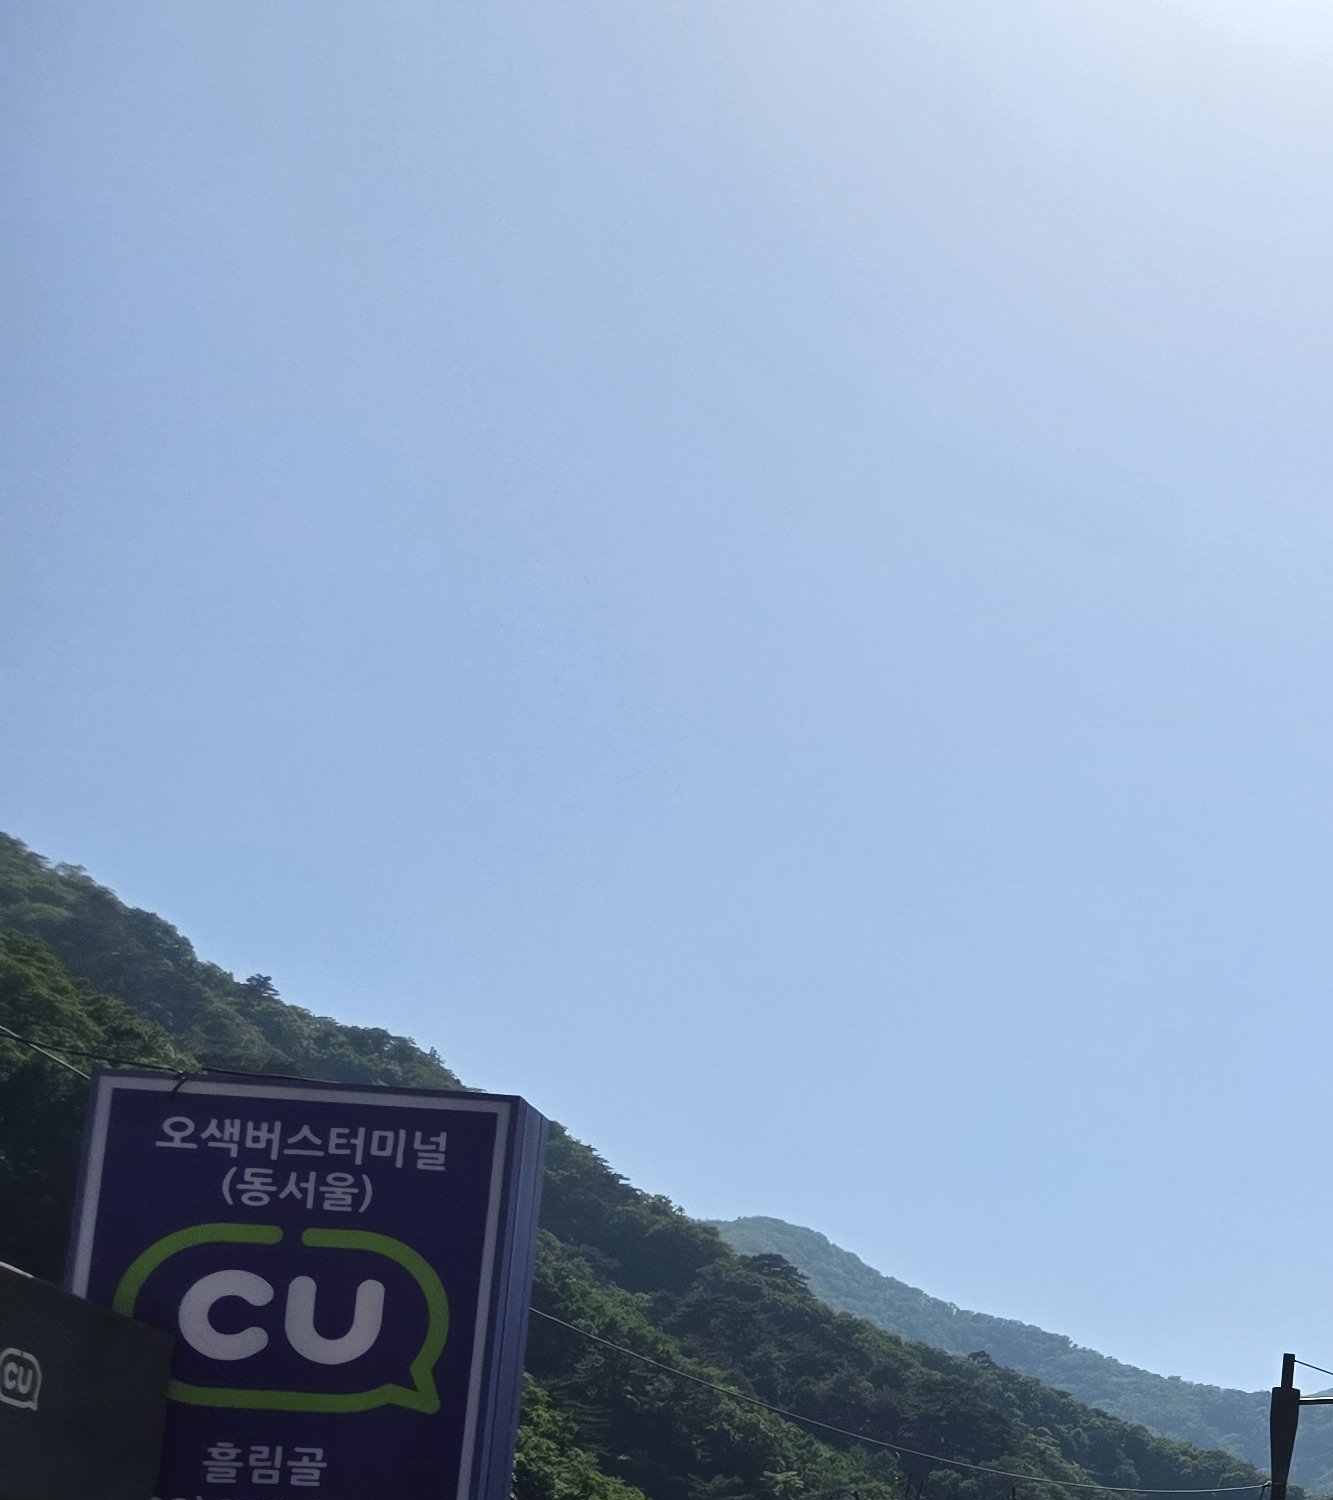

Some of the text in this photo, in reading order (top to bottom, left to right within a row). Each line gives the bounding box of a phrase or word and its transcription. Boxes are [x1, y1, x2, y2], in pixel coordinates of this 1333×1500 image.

[155, 1116, 447, 1171] 오색버스터미널
[222, 1166, 373, 1213] (동서울)
[179, 1269, 386, 1365] CU
[4, 1362, 33, 1394] CU
[202, 1442, 328, 1487] 흘림골
